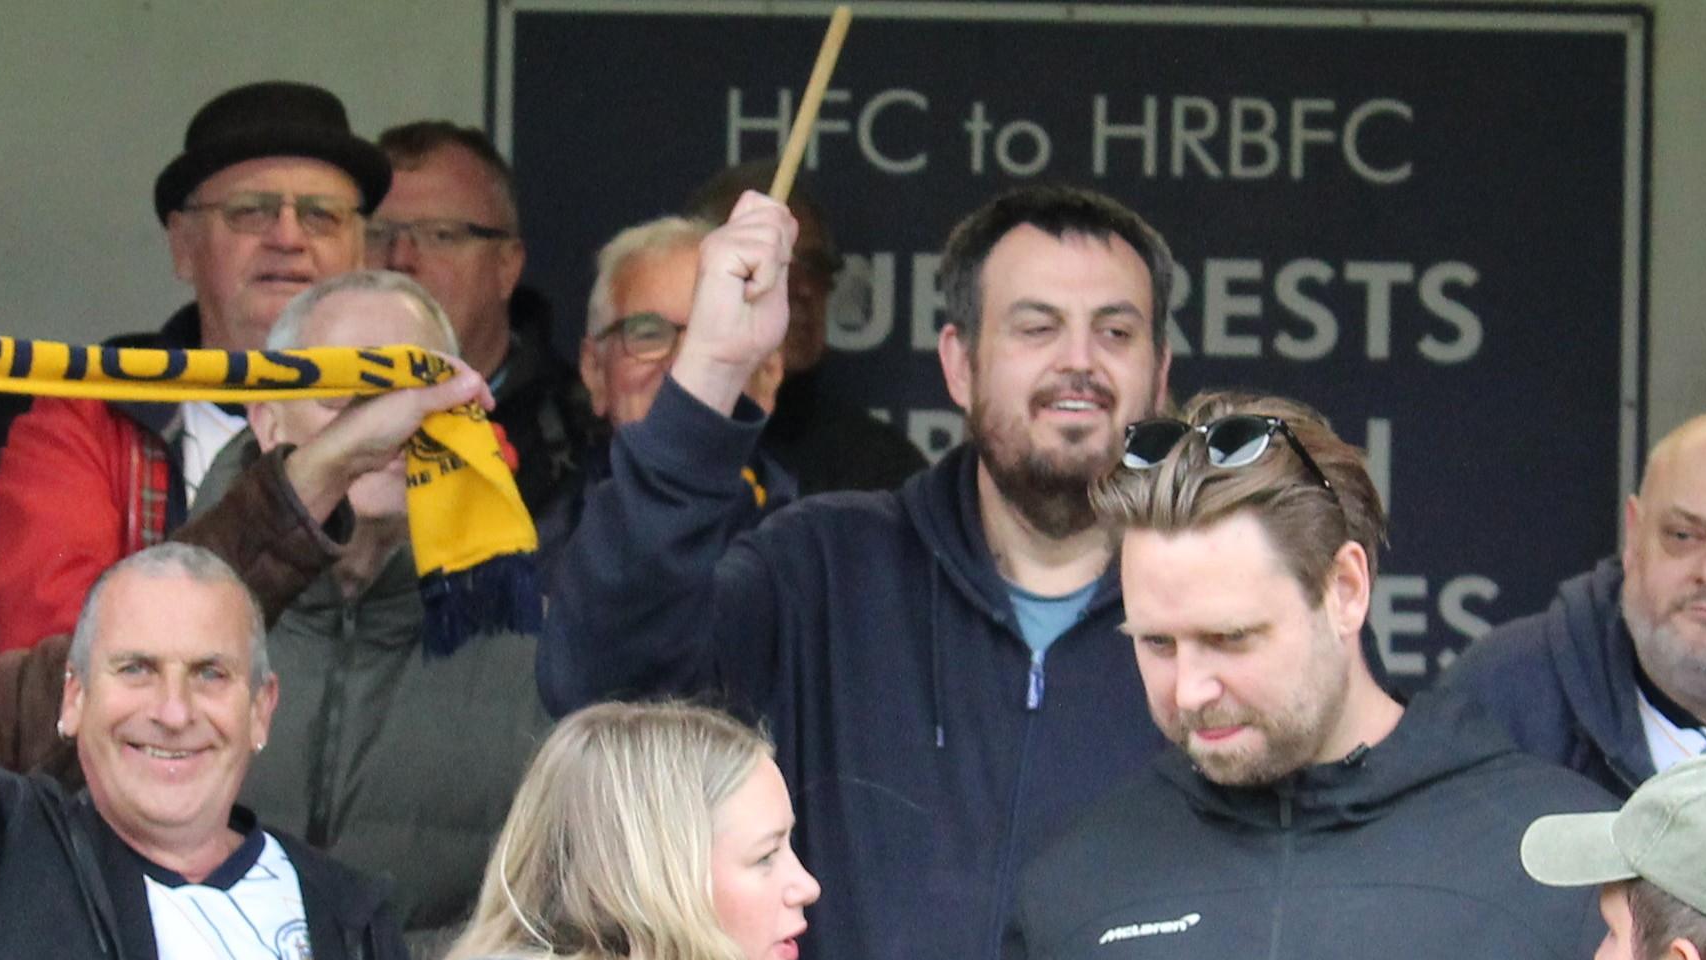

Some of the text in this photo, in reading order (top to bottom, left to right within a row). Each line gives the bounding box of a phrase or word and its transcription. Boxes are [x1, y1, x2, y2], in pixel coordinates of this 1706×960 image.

[727, 88, 1414, 184] HFC to HRBFC
[1372, 573, 1499, 673] ES
